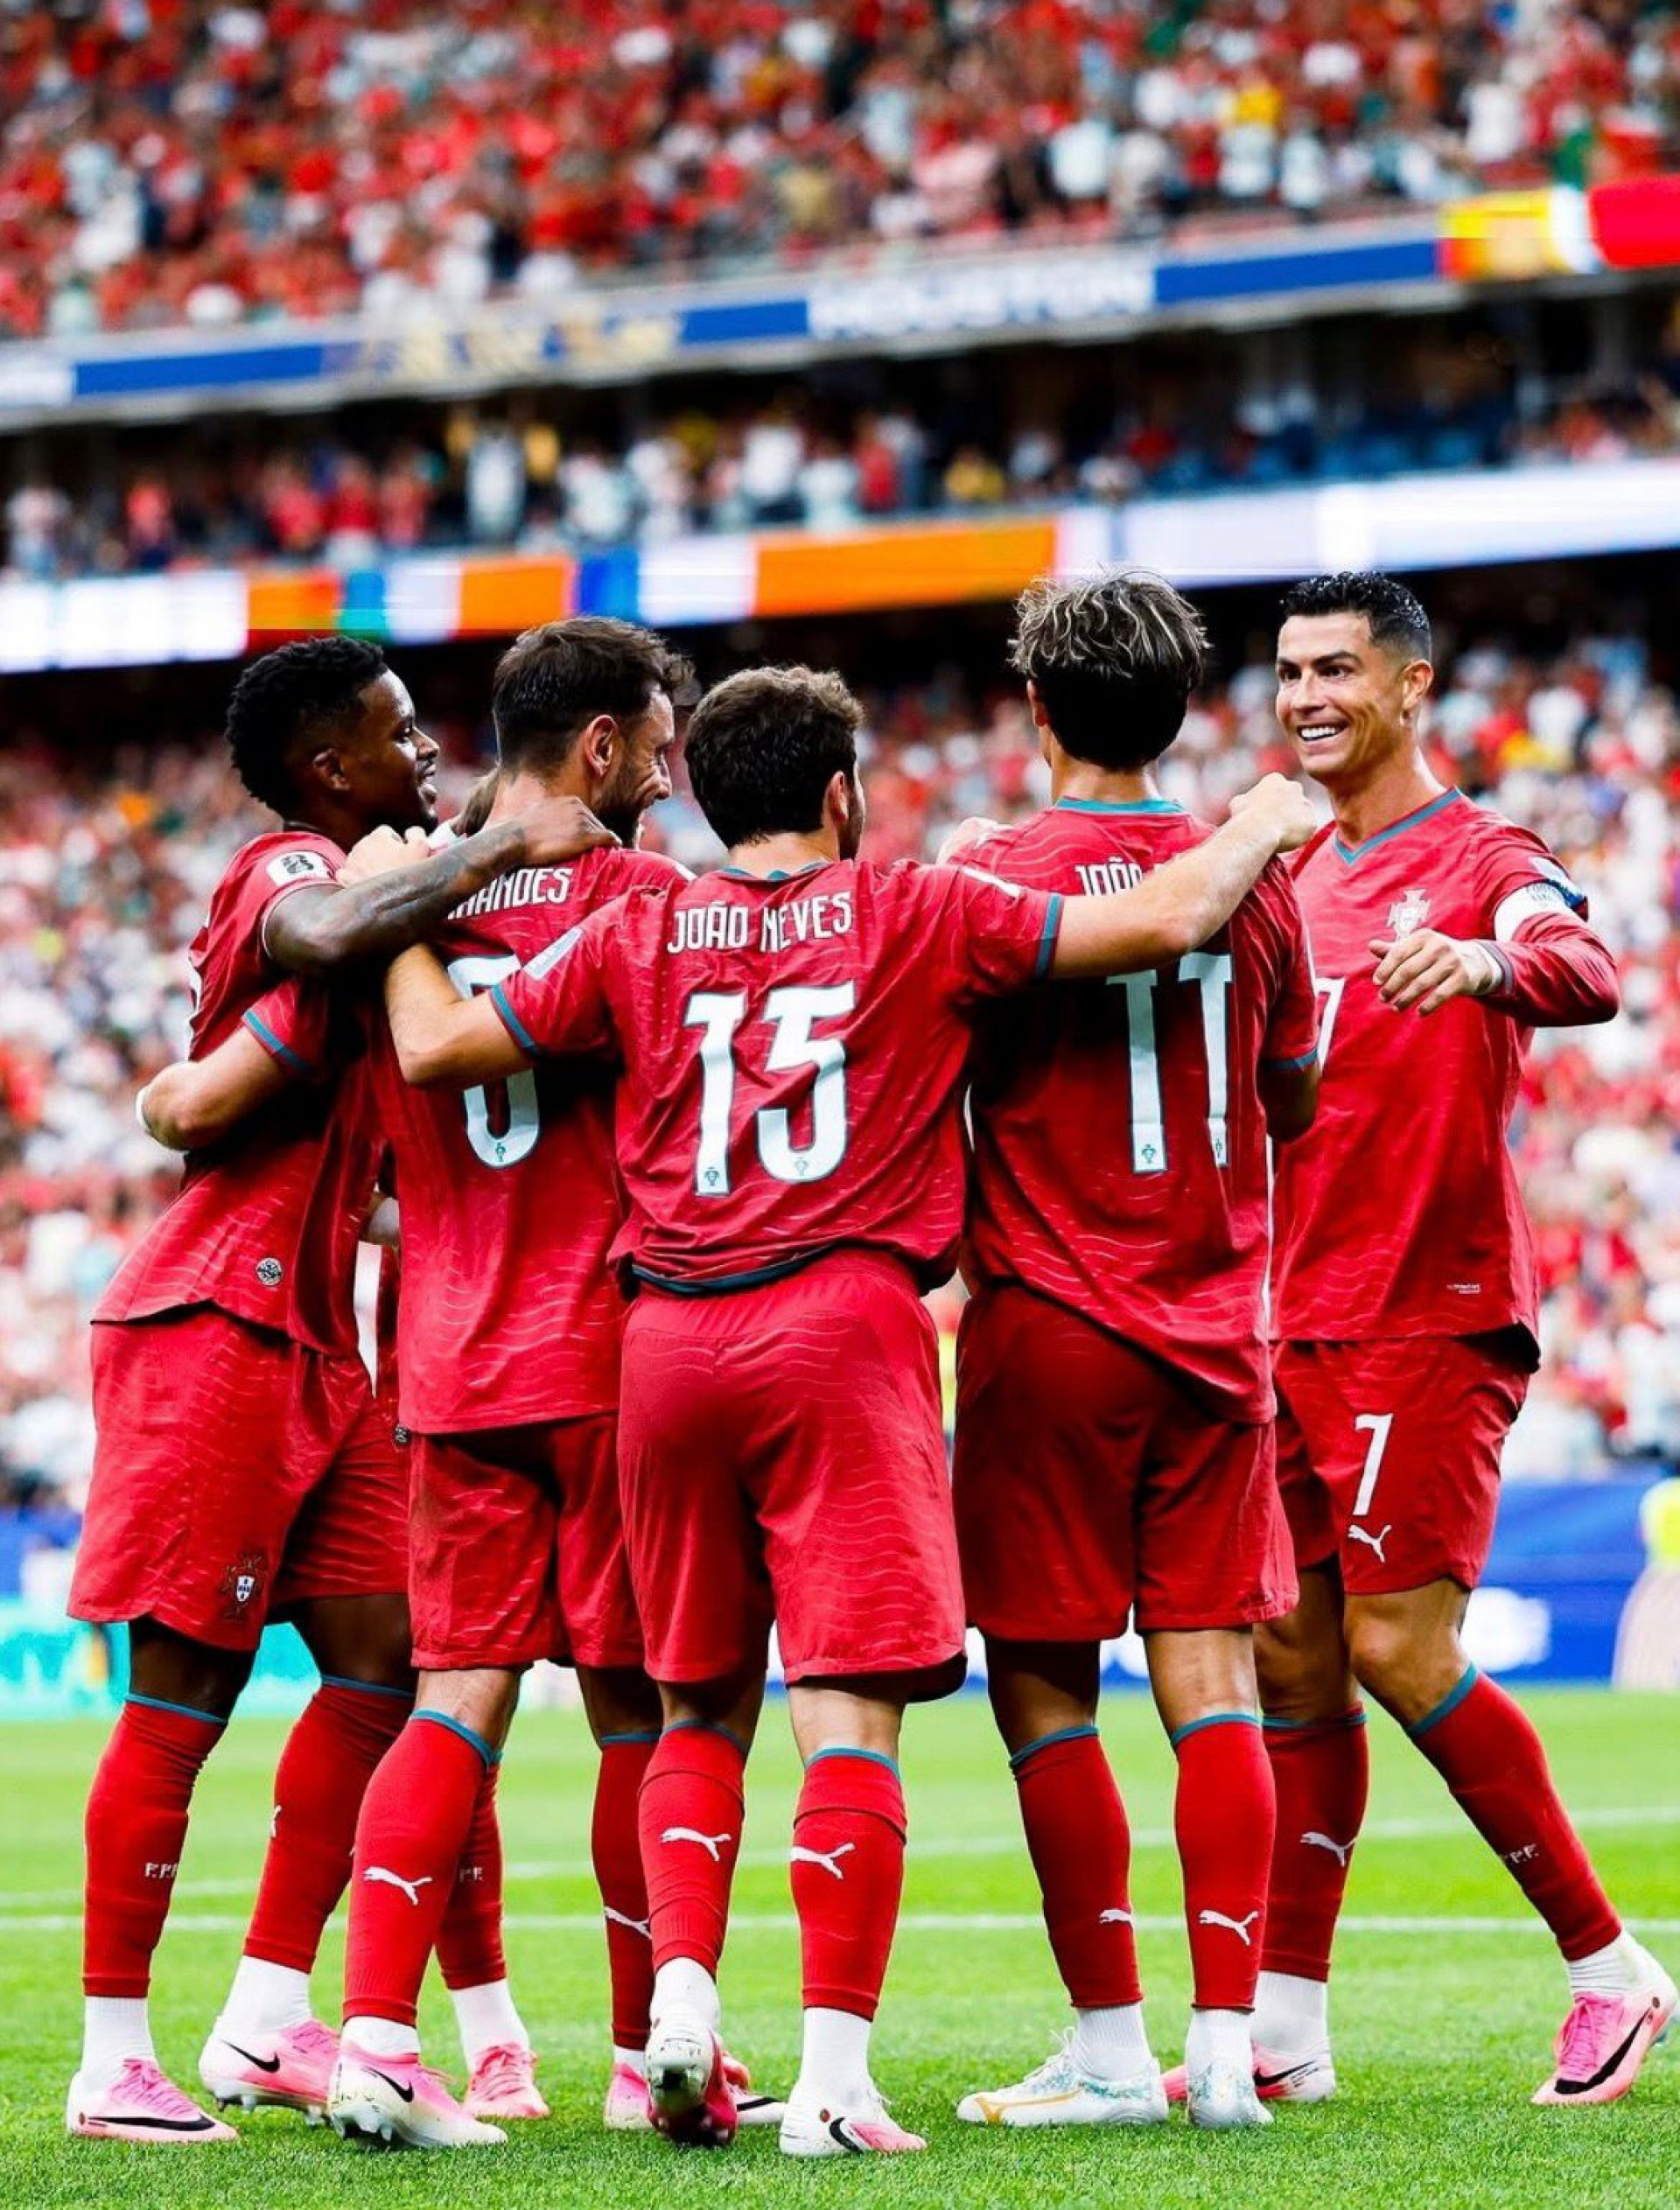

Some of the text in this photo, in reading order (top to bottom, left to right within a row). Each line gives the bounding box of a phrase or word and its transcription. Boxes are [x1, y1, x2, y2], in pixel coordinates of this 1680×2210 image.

[667, 891, 853, 955] JOÃO NEVES
[1106, 953, 1234, 1172] 11
[1313, 976, 1347, 1076] 7
[684, 980, 857, 1196] 15
[1353, 1412, 1394, 1516] 7
